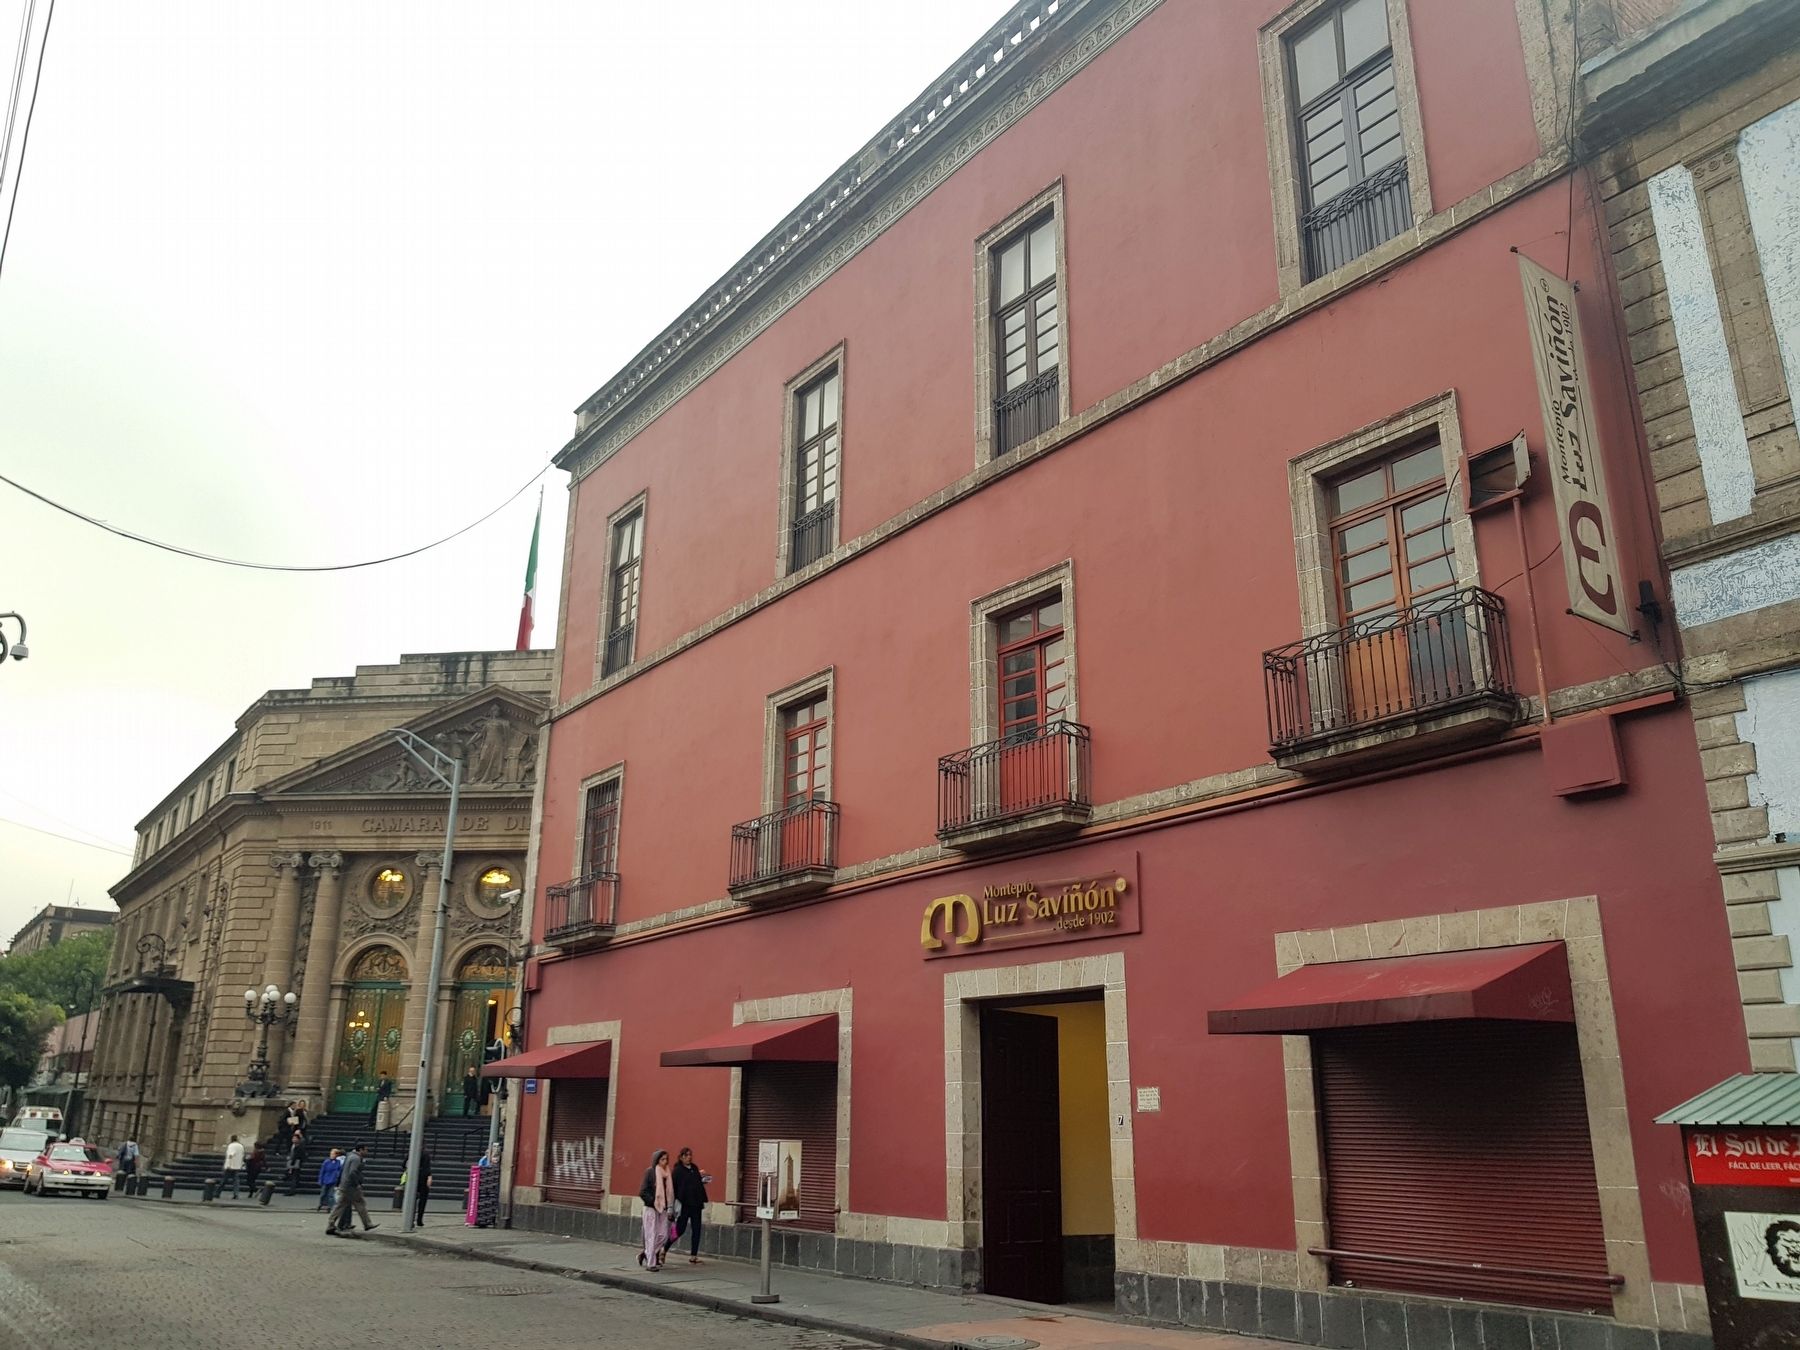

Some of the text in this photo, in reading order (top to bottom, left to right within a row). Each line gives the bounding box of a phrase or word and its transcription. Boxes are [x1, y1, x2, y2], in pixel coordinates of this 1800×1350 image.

[460, 817, 489, 831] DE
[983, 900, 1018, 926] Luz
[1057, 911, 1115, 930] desde 1902
[1693, 1134, 1719, 1157] El
[1725, 1133, 1764, 1157] Sol
[1765, 1136, 1790, 1156] de
[1750, 1161, 1761, 1170] DE
